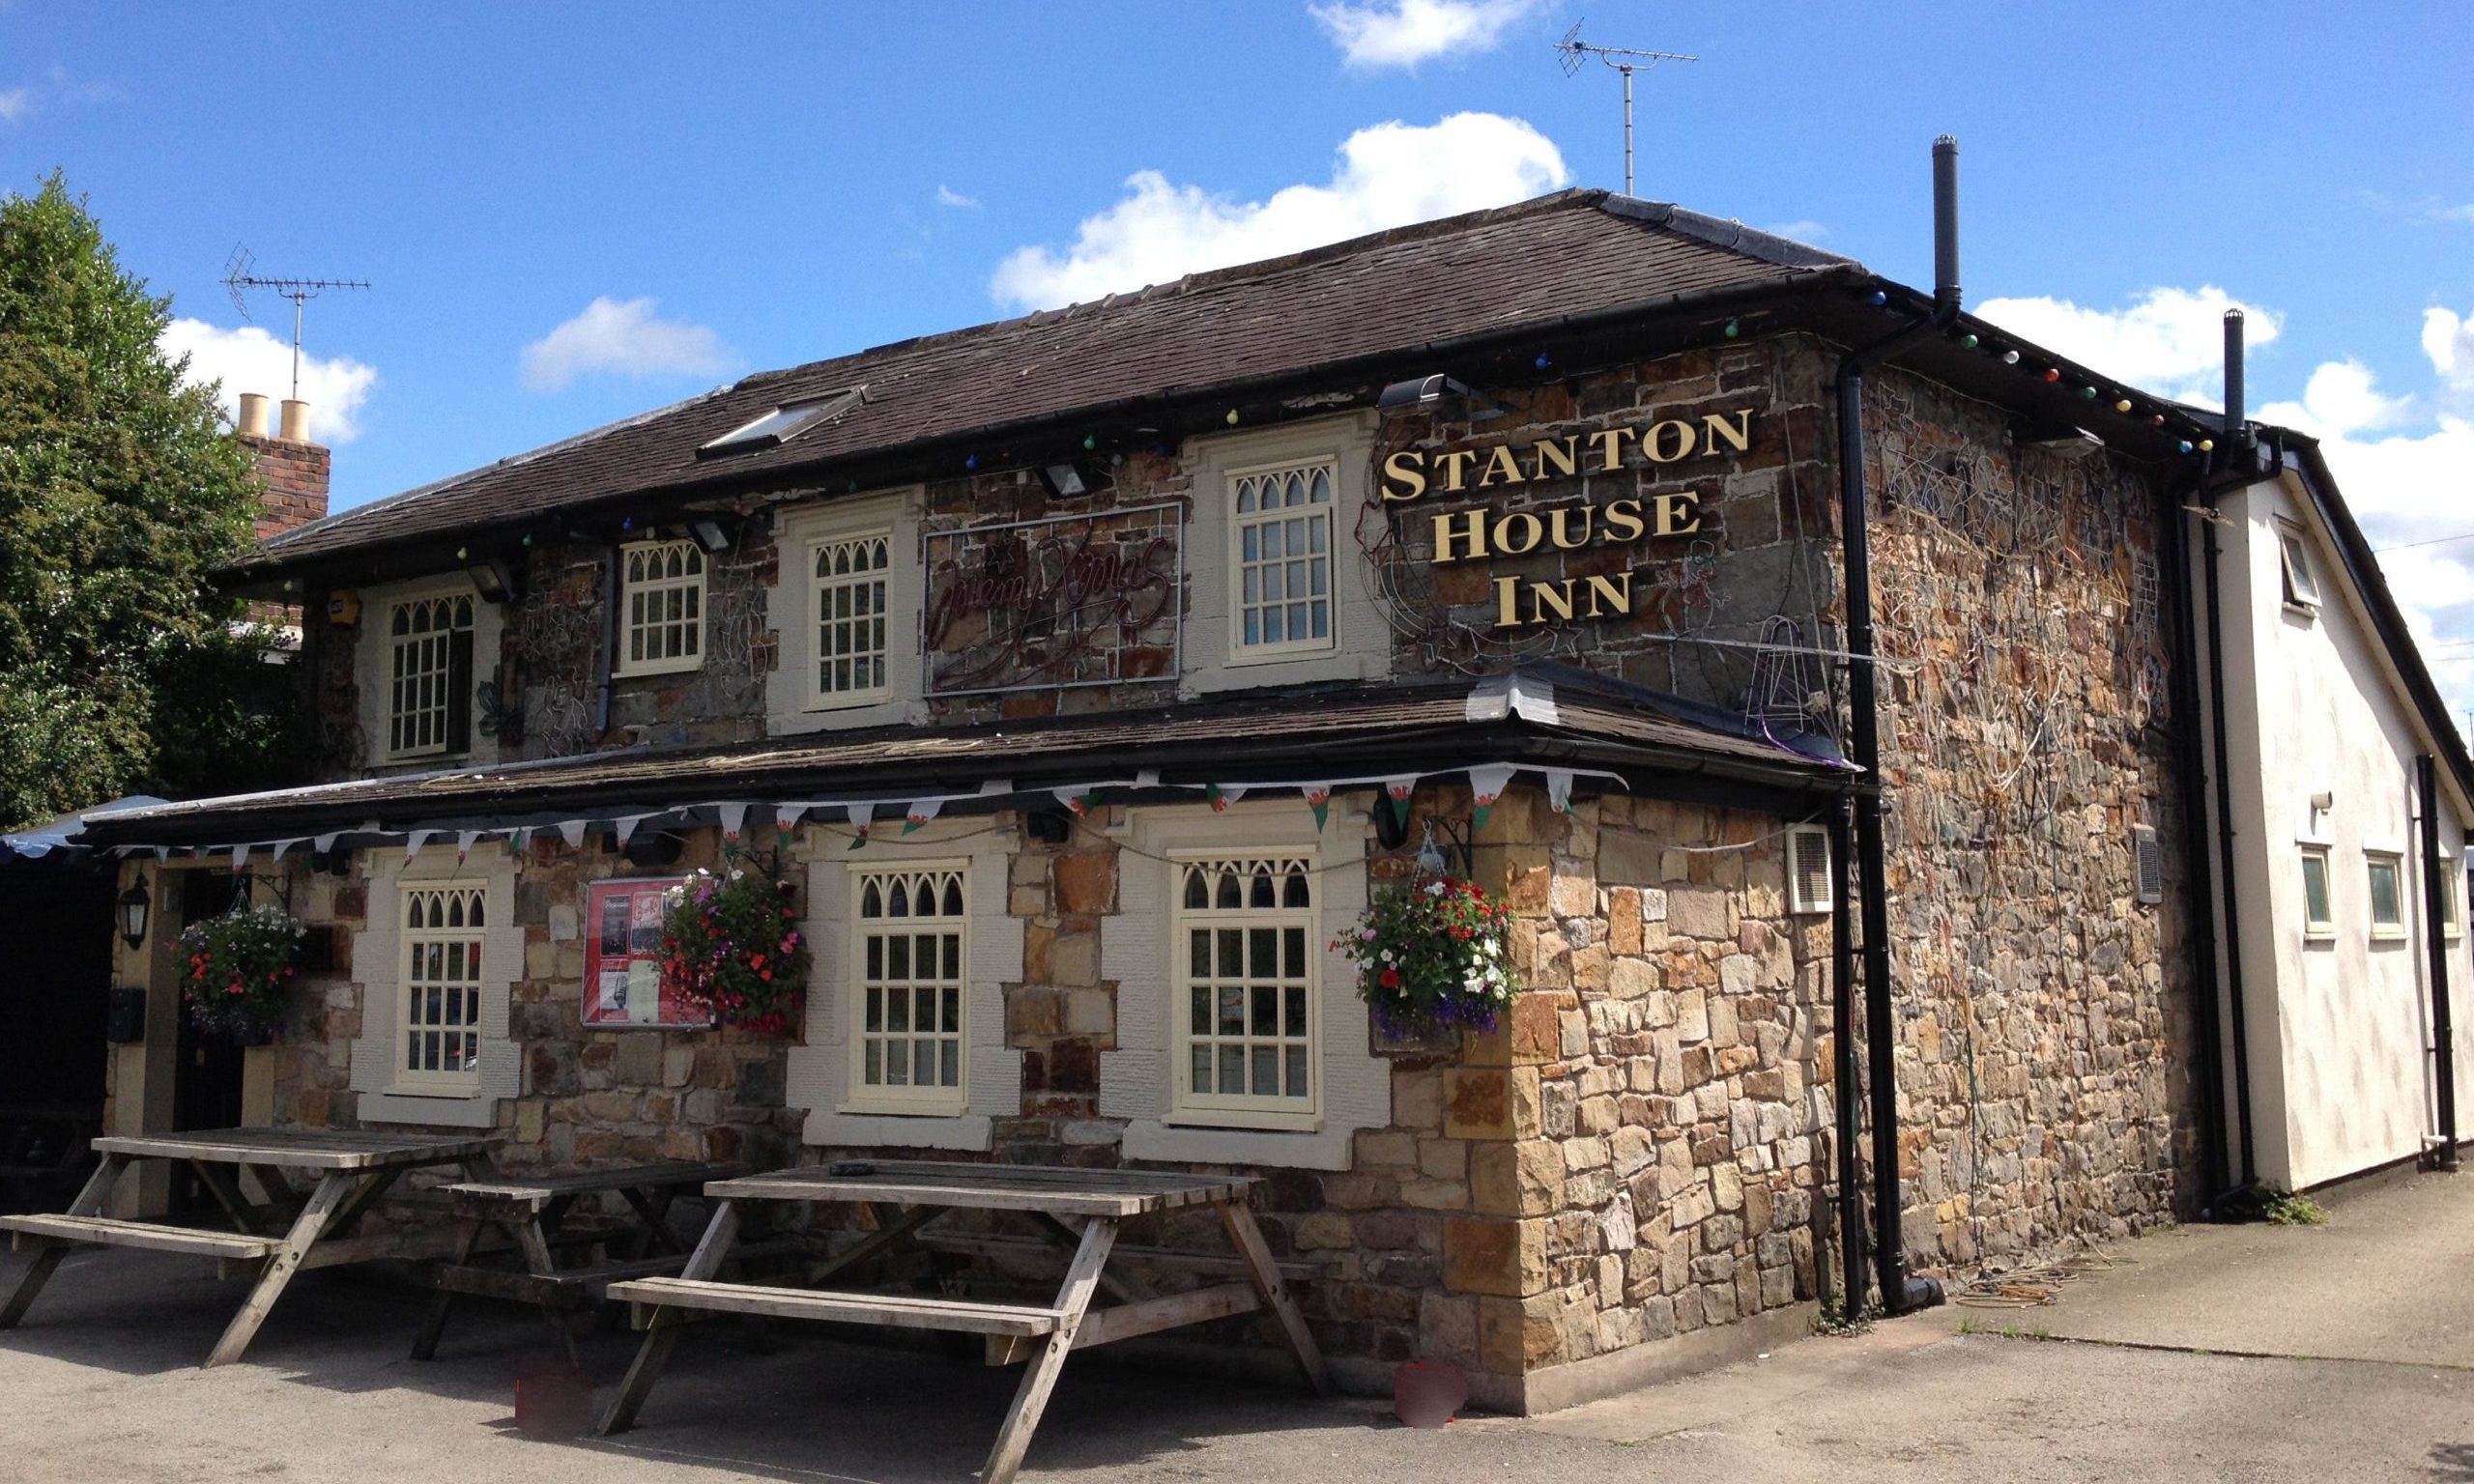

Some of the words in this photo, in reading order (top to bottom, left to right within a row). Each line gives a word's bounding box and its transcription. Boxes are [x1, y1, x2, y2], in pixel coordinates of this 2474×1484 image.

[1382, 409, 1754, 500] STANTON
[1430, 490, 1701, 563] HOUSE
[1493, 572, 1633, 627] INN
